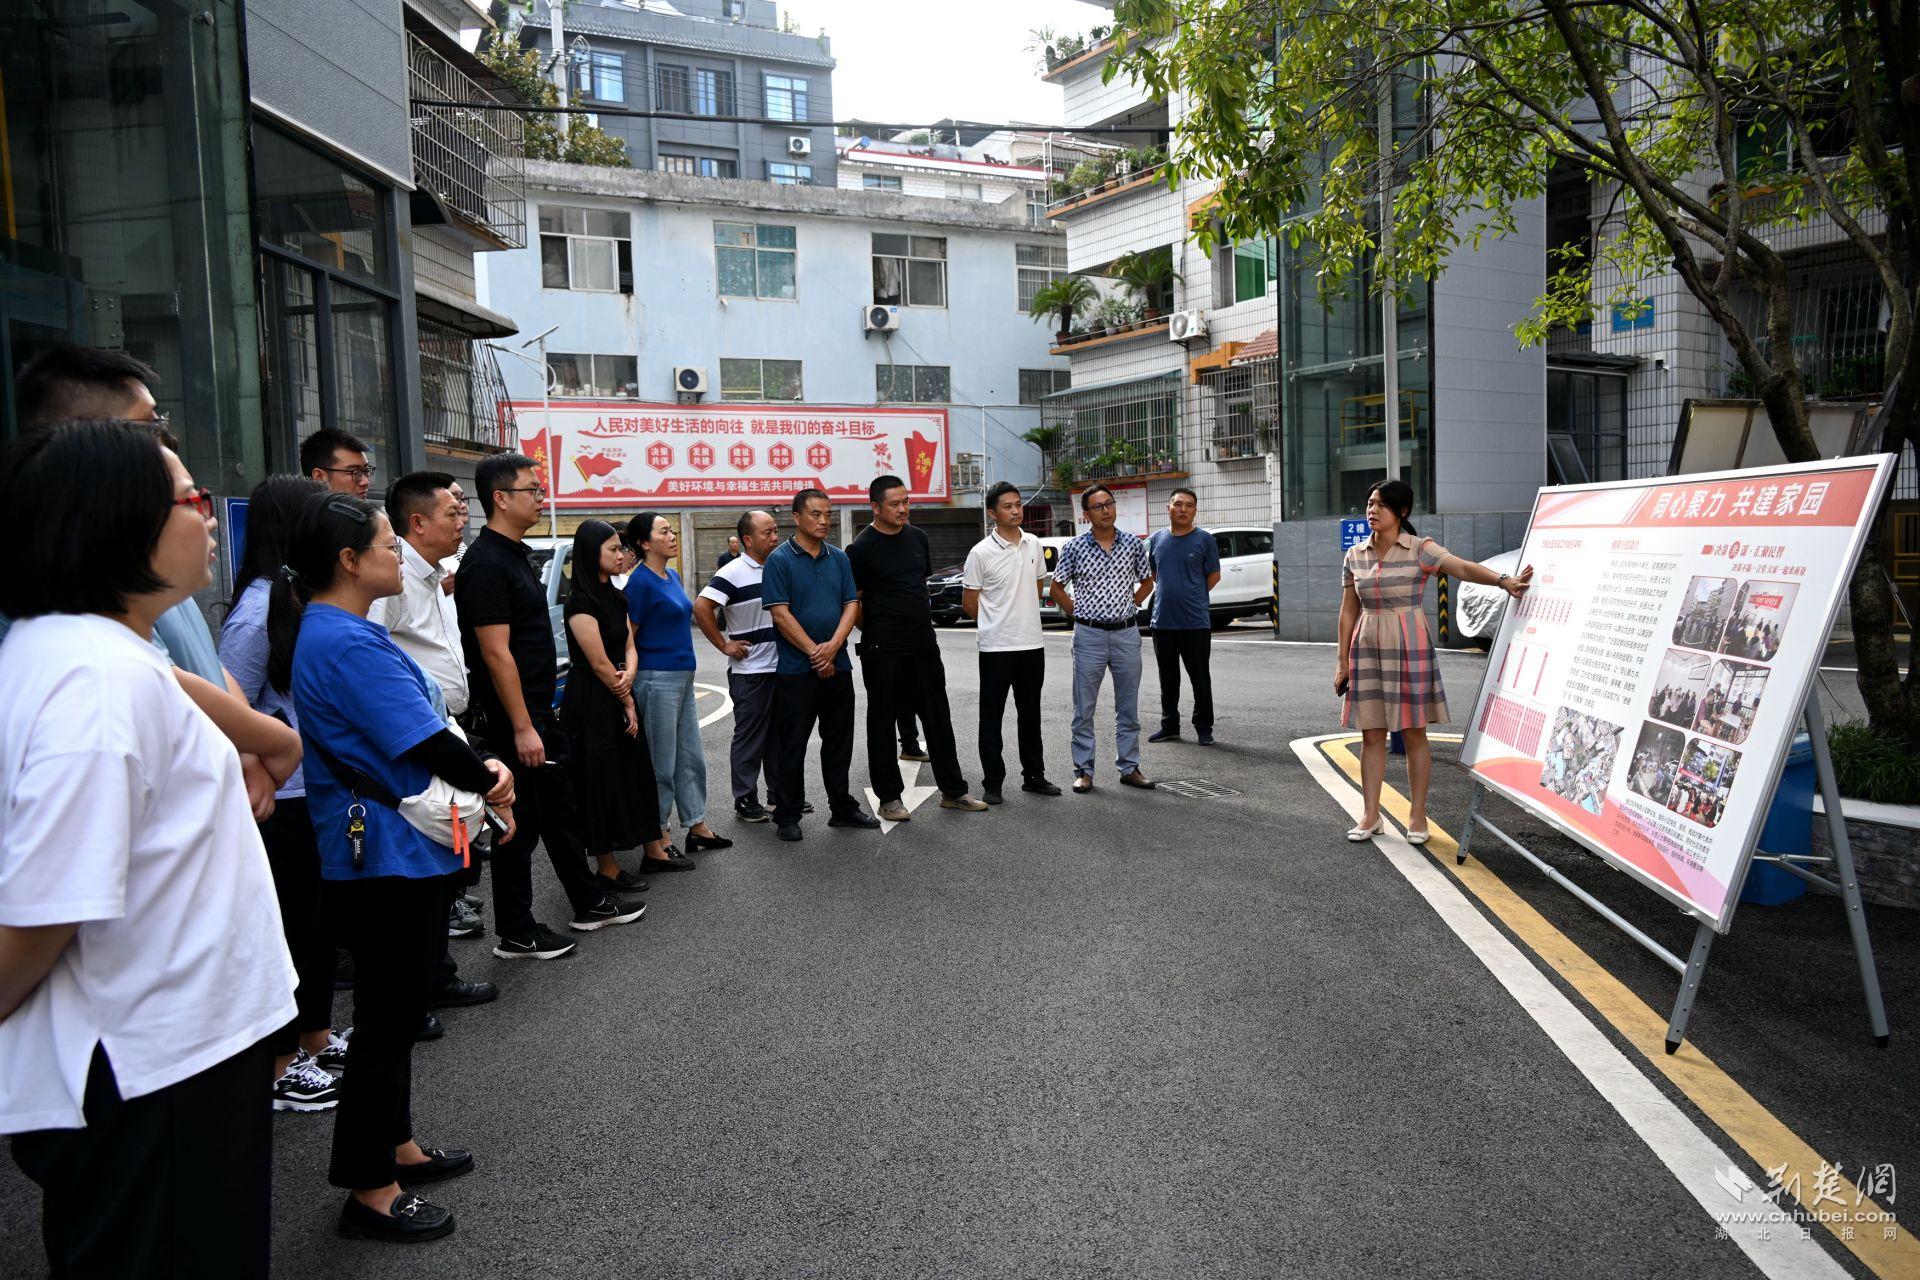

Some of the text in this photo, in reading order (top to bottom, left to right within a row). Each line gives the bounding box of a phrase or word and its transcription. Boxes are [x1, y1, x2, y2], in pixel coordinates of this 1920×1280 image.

[593, 417, 876, 436] 人民对美好生活的向往 就是我们的奋斗目标
[651, 448, 668, 457] 决策
[693, 448, 709, 457] 发展
[733, 448, 749, 457] 建设
[773, 448, 788, 457] 效果
[811, 448, 826, 457] 成果
[652, 457, 669, 466] 共谋
[693, 457, 710, 466] 共建
[733, 457, 750, 466] 共管
[773, 457, 789, 466] 共评
[811, 457, 827, 466] 共享
[667, 480, 815, 493] 美好环境与幸福生活共同缔造
[1650, 481, 1831, 520] 同心聚力 共建家园
